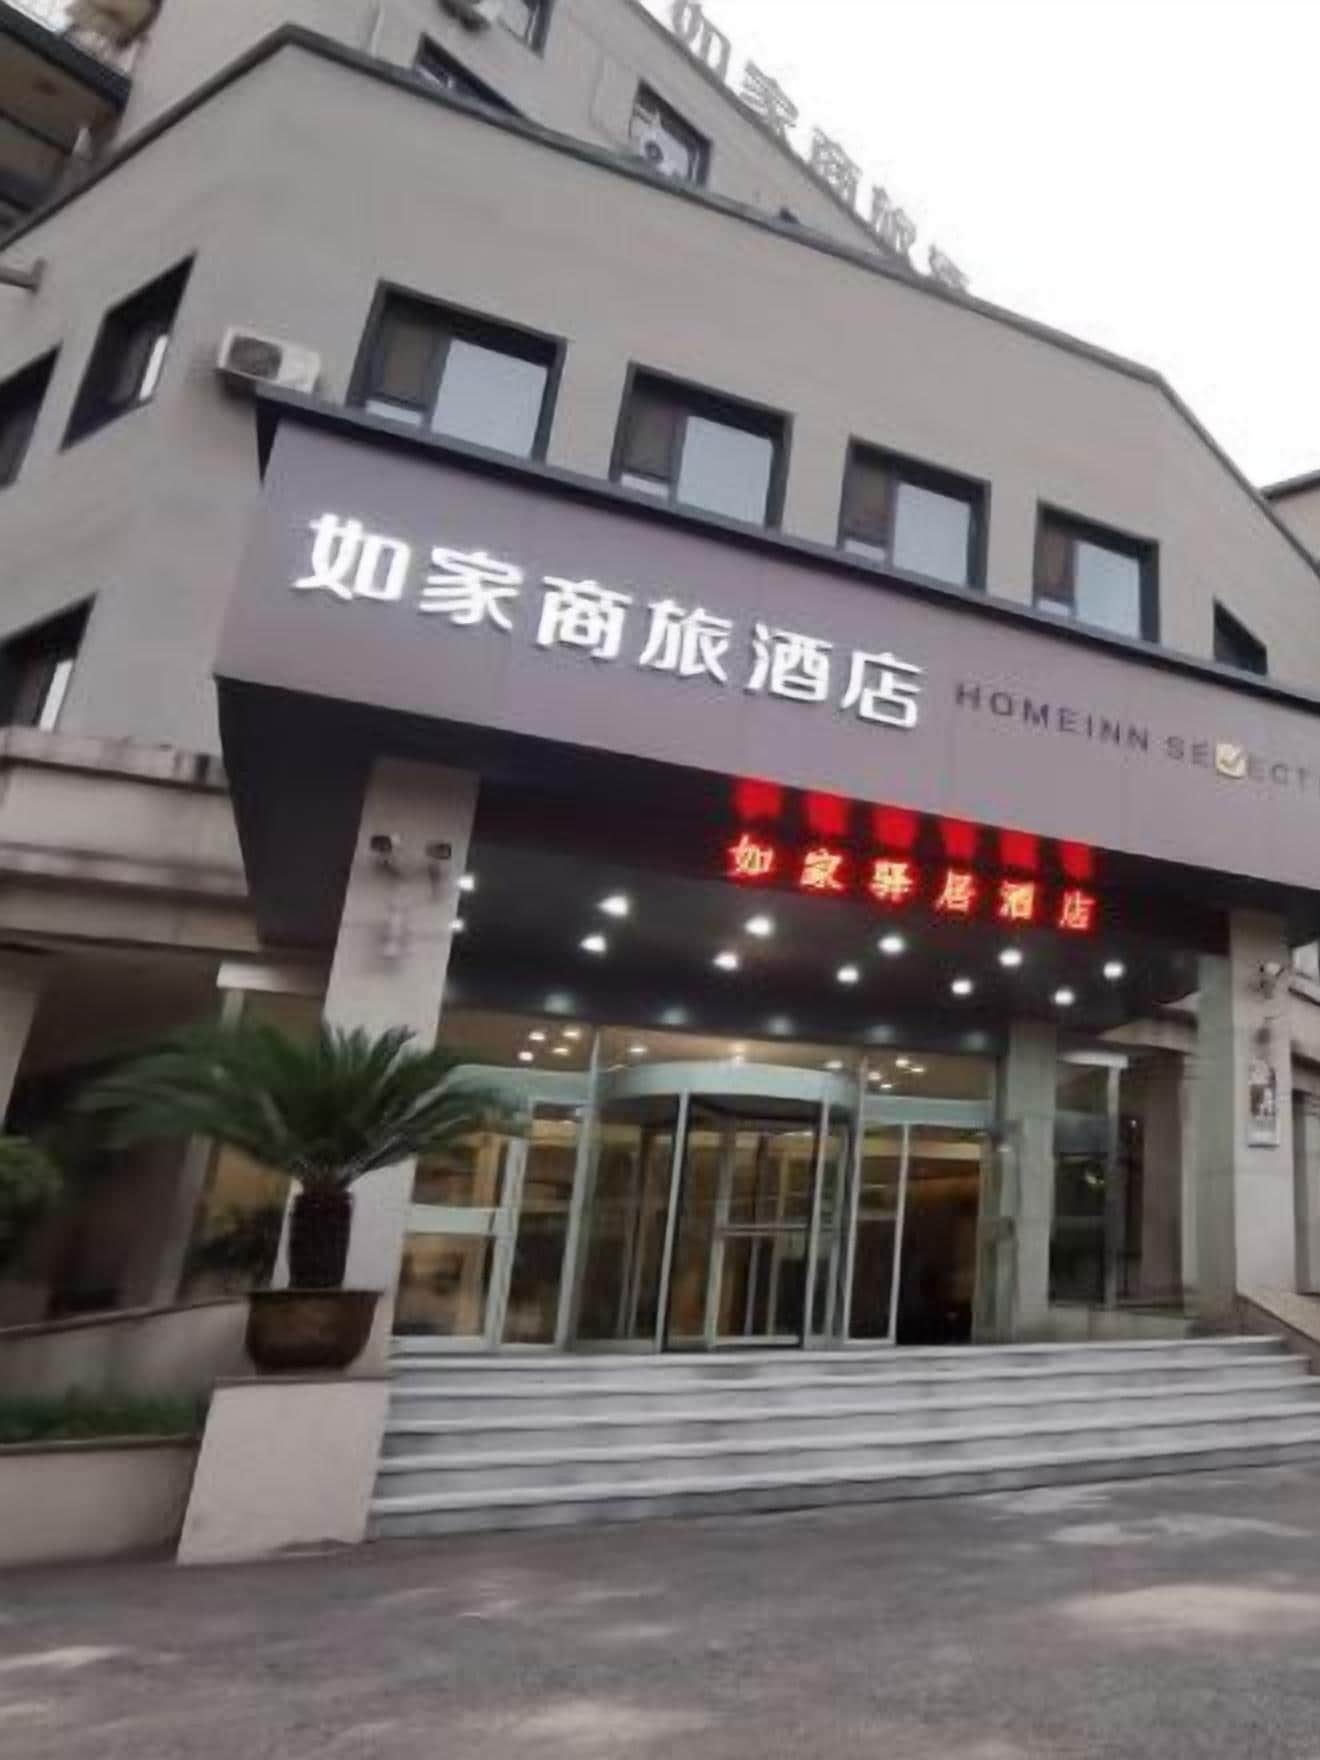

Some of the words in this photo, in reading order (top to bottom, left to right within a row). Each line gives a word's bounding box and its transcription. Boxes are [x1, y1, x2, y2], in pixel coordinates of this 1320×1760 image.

[293, 513, 924, 729] 如家商旅酒店
[955, 682, 1149, 752] HOMEINN
